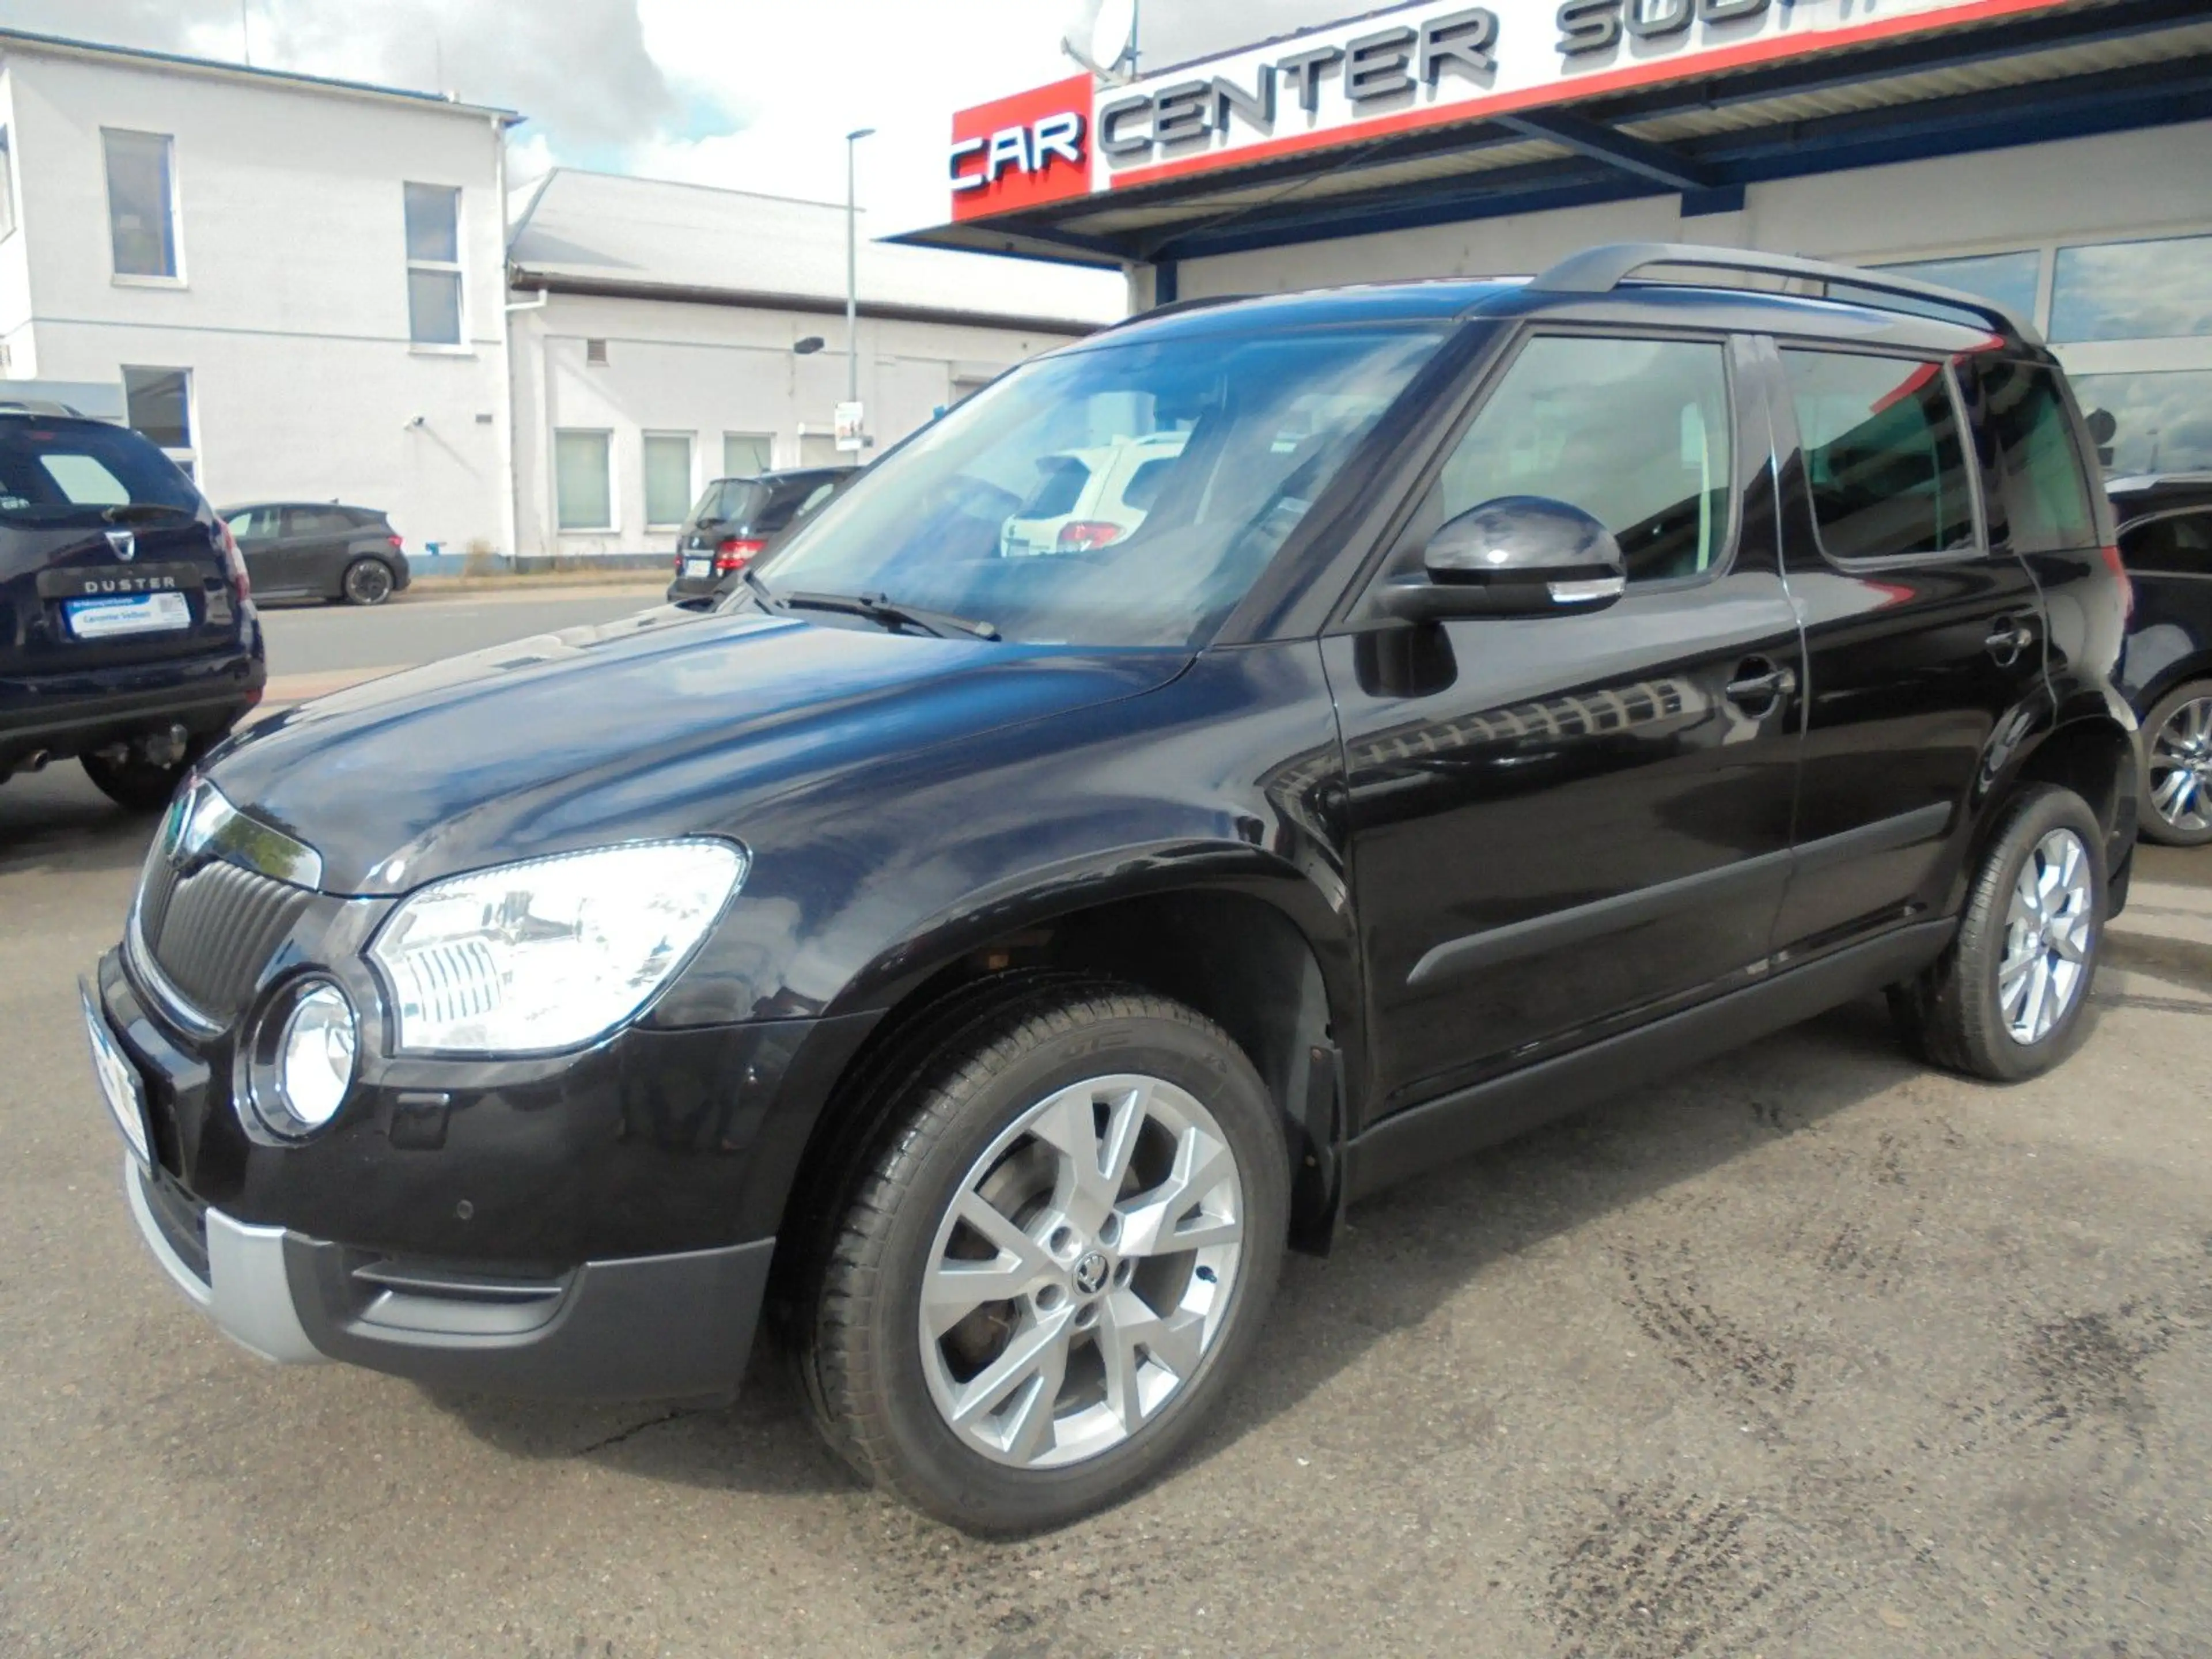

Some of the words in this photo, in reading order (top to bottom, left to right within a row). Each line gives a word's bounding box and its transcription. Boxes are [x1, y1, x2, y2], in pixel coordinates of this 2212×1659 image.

[949, 111, 1086, 192] CAR
[1098, 6, 1499, 156] CENTER
[85, 577, 175, 593] DUSTER
